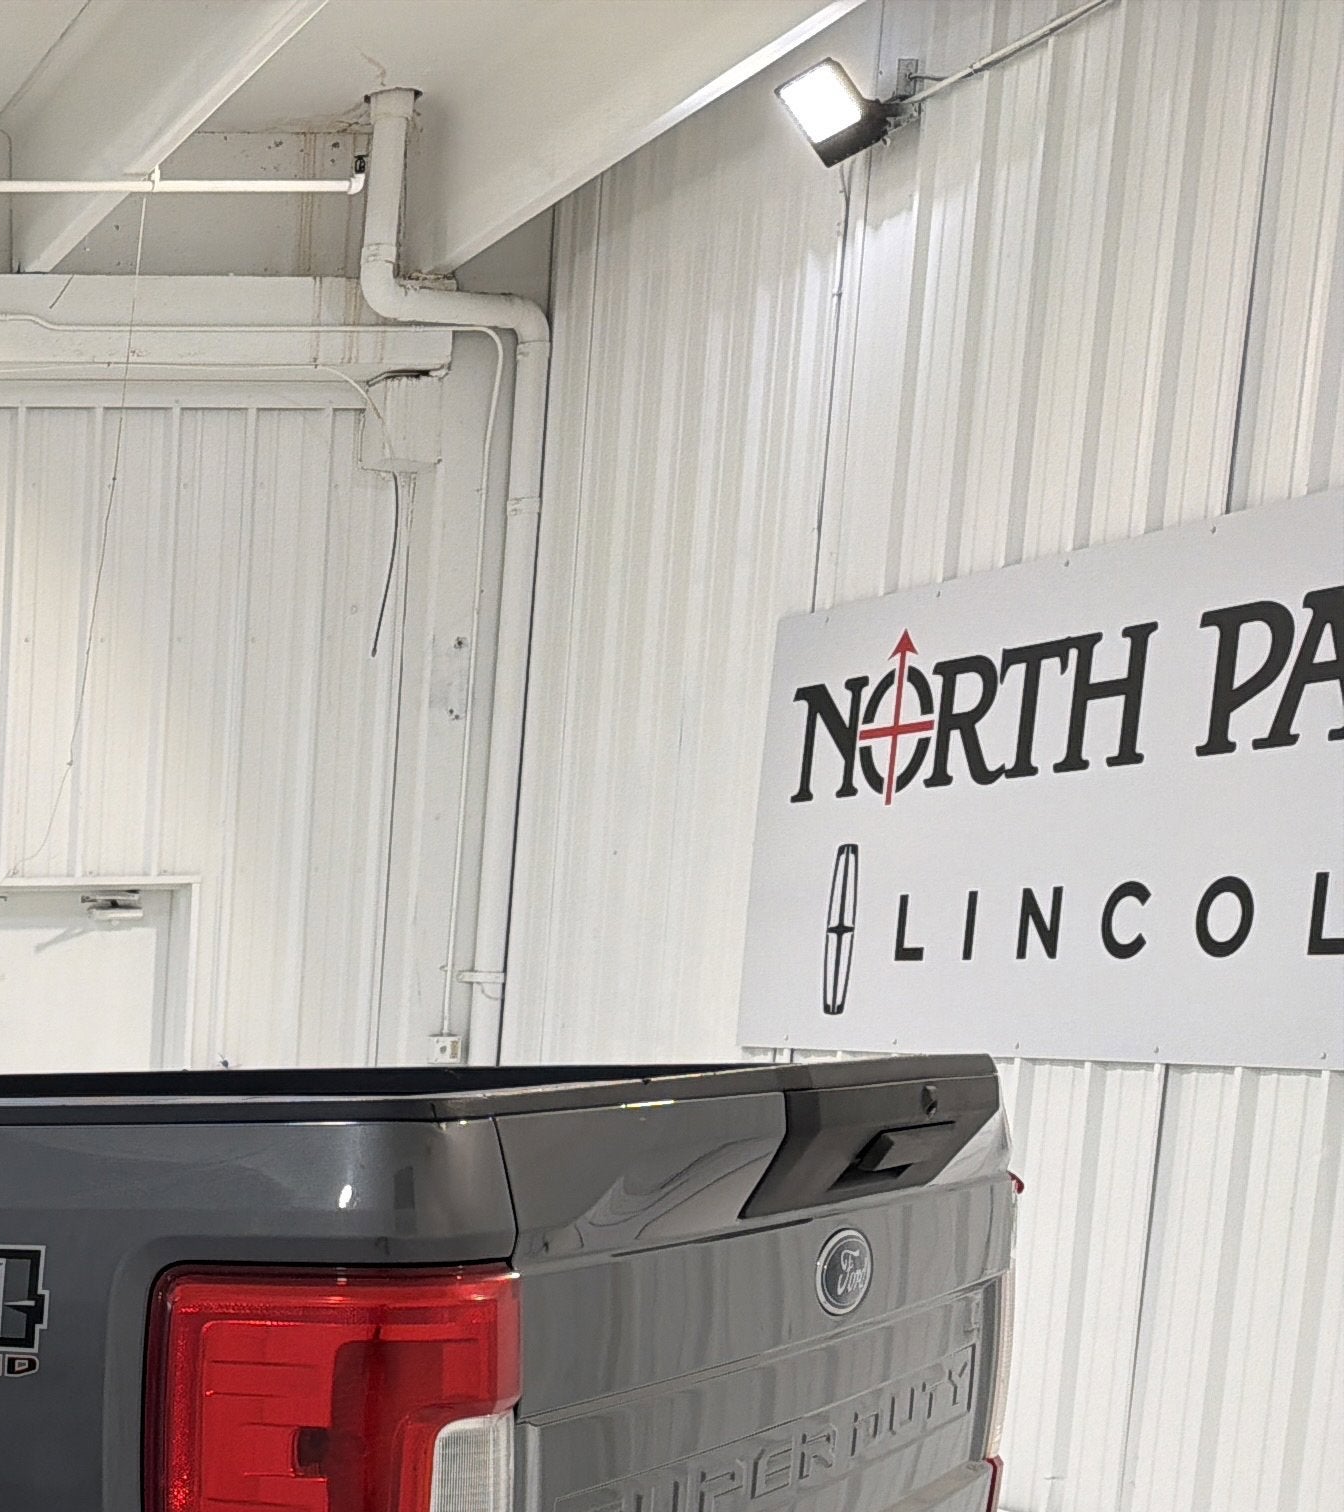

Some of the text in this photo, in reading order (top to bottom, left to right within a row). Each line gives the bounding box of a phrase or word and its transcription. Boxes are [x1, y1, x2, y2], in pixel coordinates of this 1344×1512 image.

[790, 621, 1159, 805] NORTH
[895, 871, 1344, 962] LINCOL
[849, 1359, 970, 1457] DUTY
